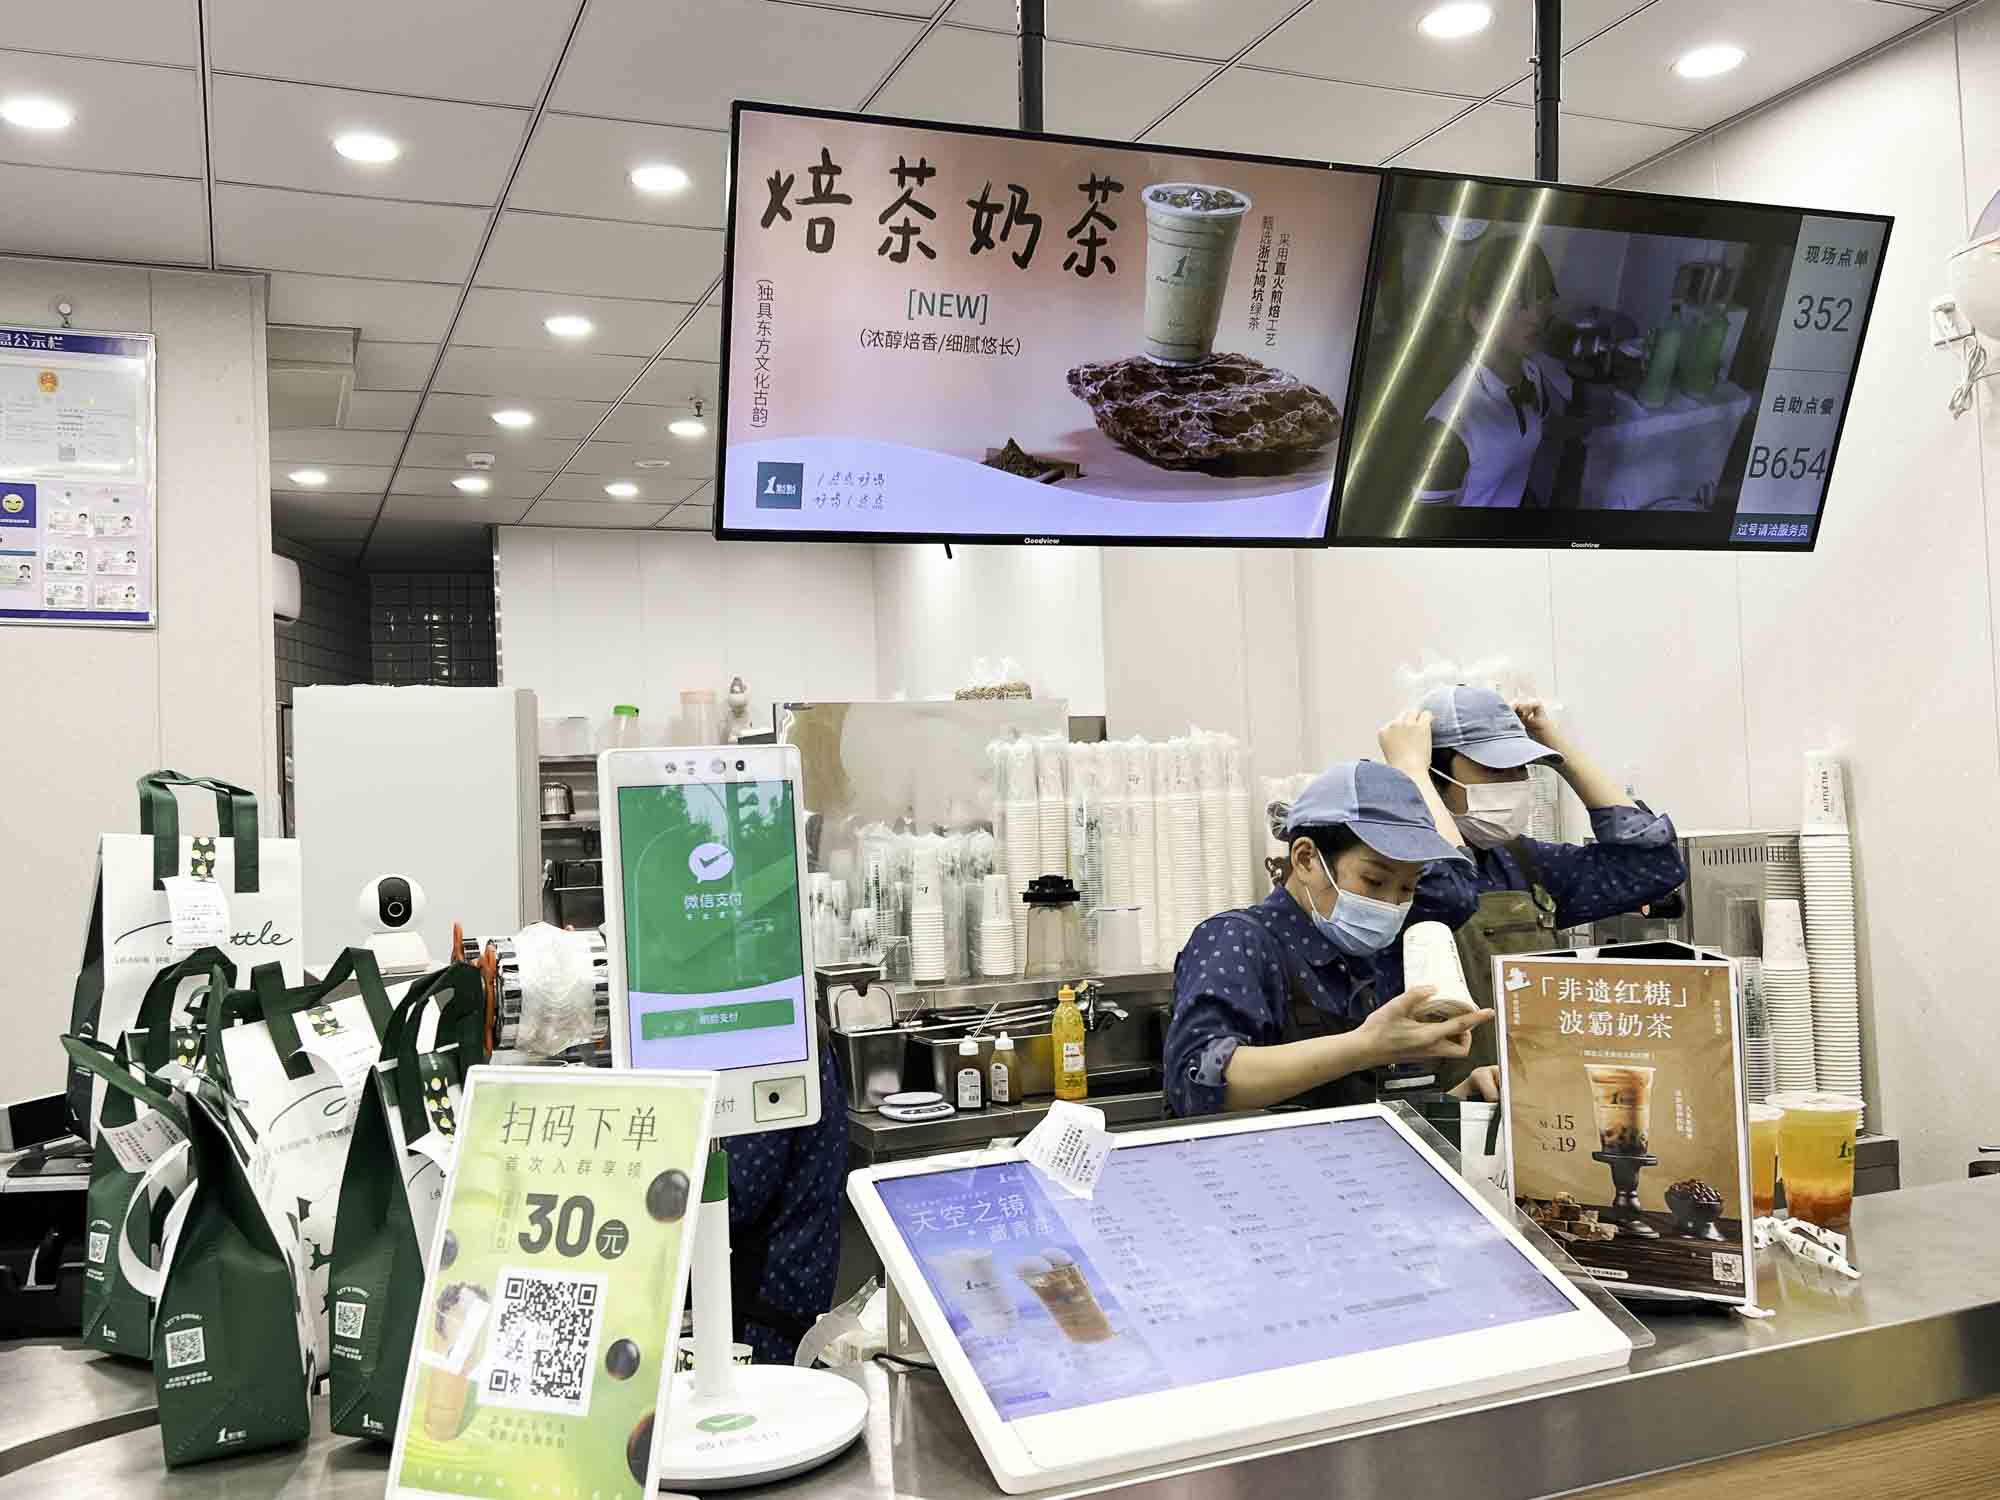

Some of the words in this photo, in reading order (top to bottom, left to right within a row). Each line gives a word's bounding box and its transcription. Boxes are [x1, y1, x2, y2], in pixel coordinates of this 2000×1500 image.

[760, 147, 1124, 278] 焙茶奶茶
[1804, 246, 1869, 268] 现场点单
[1265, 233, 1290, 346] 采用直火煎焙工艺
[1793, 295, 1853, 332] 352
[1772, 394, 1834, 415] 自助点餐
[1749, 446, 1826, 480] B654
[1736, 523, 1808, 536] 过号请洽服务员
[684, 893, 743, 910] 微信支付
[1559, 1009, 1673, 1039] 波霸奶茶
[501, 1101, 658, 1151] 扫码下单
[1555, 1114, 1575, 1130] 15
[1557, 1137, 1577, 1152] 19
[911, 1194, 1025, 1233] 天空之镜
